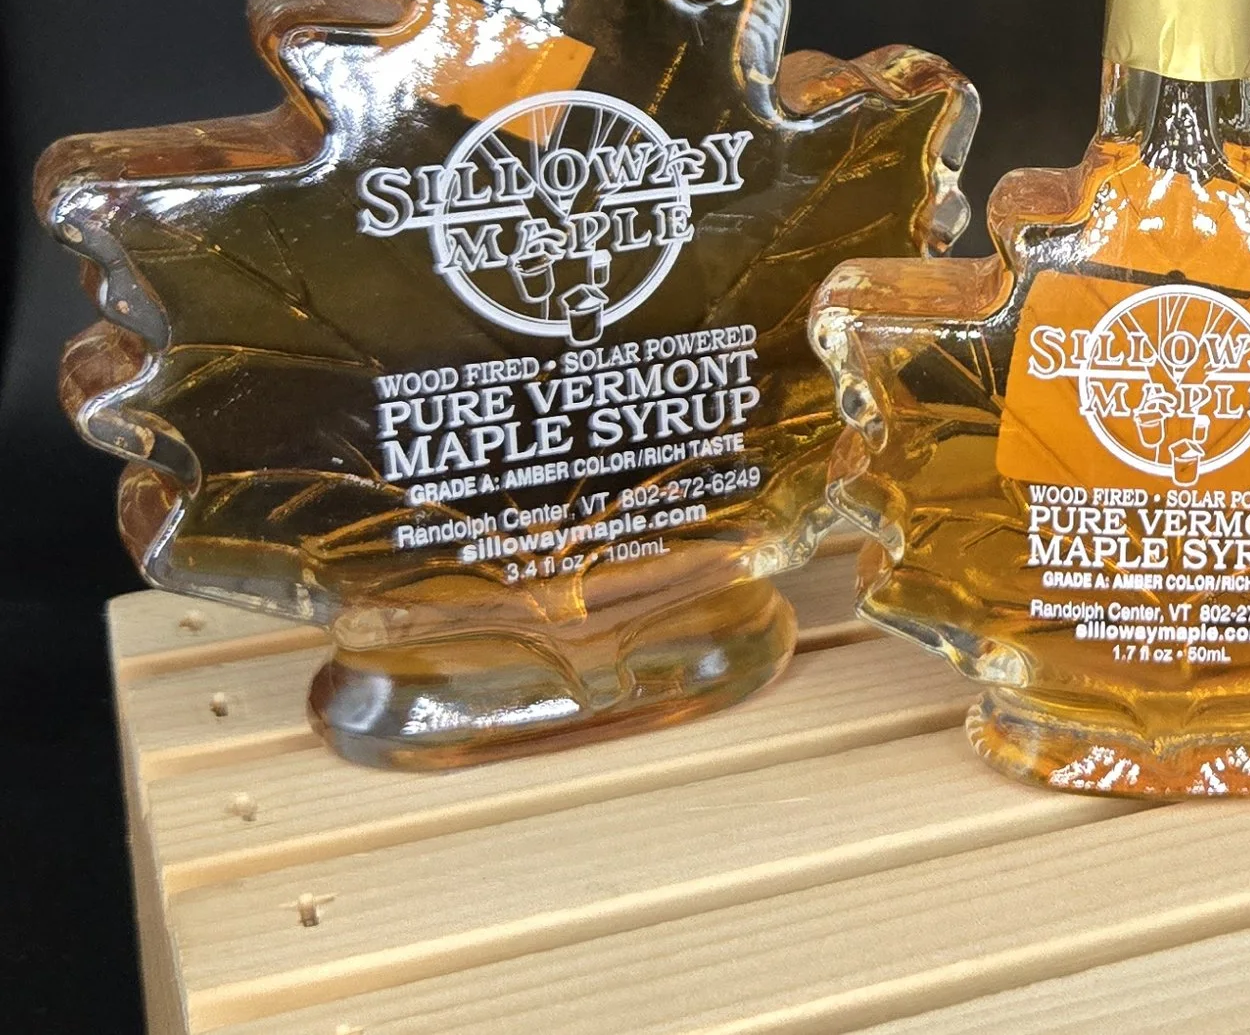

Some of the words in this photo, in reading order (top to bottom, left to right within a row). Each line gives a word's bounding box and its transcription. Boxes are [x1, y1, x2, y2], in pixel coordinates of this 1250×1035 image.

[436, 204, 695, 274] MAPLE
[377, 370, 458, 399] WOOD
[466, 357, 539, 386] FIRED
[565, 343, 639, 374] SOLAR
[647, 325, 757, 360] POWERED
[378, 387, 514, 437] PURE
[525, 350, 757, 413] VERMONT
[383, 418, 573, 481] MAPLE
[590, 387, 761, 448] SYRUP
[410, 477, 475, 506] GRADE
[478, 473, 499, 492] A:
[505, 461, 569, 489] AMBER
[574, 442, 686, 478] COLOR/RICH
[689, 433, 744, 457] TASTE
[1030, 485, 1088, 505] WOOD
[1093, 488, 1148, 506] FIRED
[1166, 490, 1225, 507] SOLAR
[397, 513, 497, 549] Randolph
[504, 499, 575, 528] Center,
[579, 491, 609, 515] VT
[620, 467, 761, 509] 802-272-6249
[459, 503, 707, 563] sillowaymaple.com
[1029, 506, 1126, 535] PURE
[505, 562, 539, 582] 3.4
[561, 557, 585, 573] oz
[607, 536, 670, 563] 100mL
[1028, 535, 1169, 567] MAPLE
[1042, 573, 1093, 587] GRADE
[1095, 575, 1110, 588] A:
[1112, 575, 1162, 589] AMBER
[1030, 600, 1104, 620] Randolph
[1108, 602, 1163, 623] Center,
[1168, 605, 1191, 621] VT
[1112, 646, 1134, 660] 1.7
[1152, 649, 1173, 661] oz
[1188, 647, 1231, 662] 50mL
